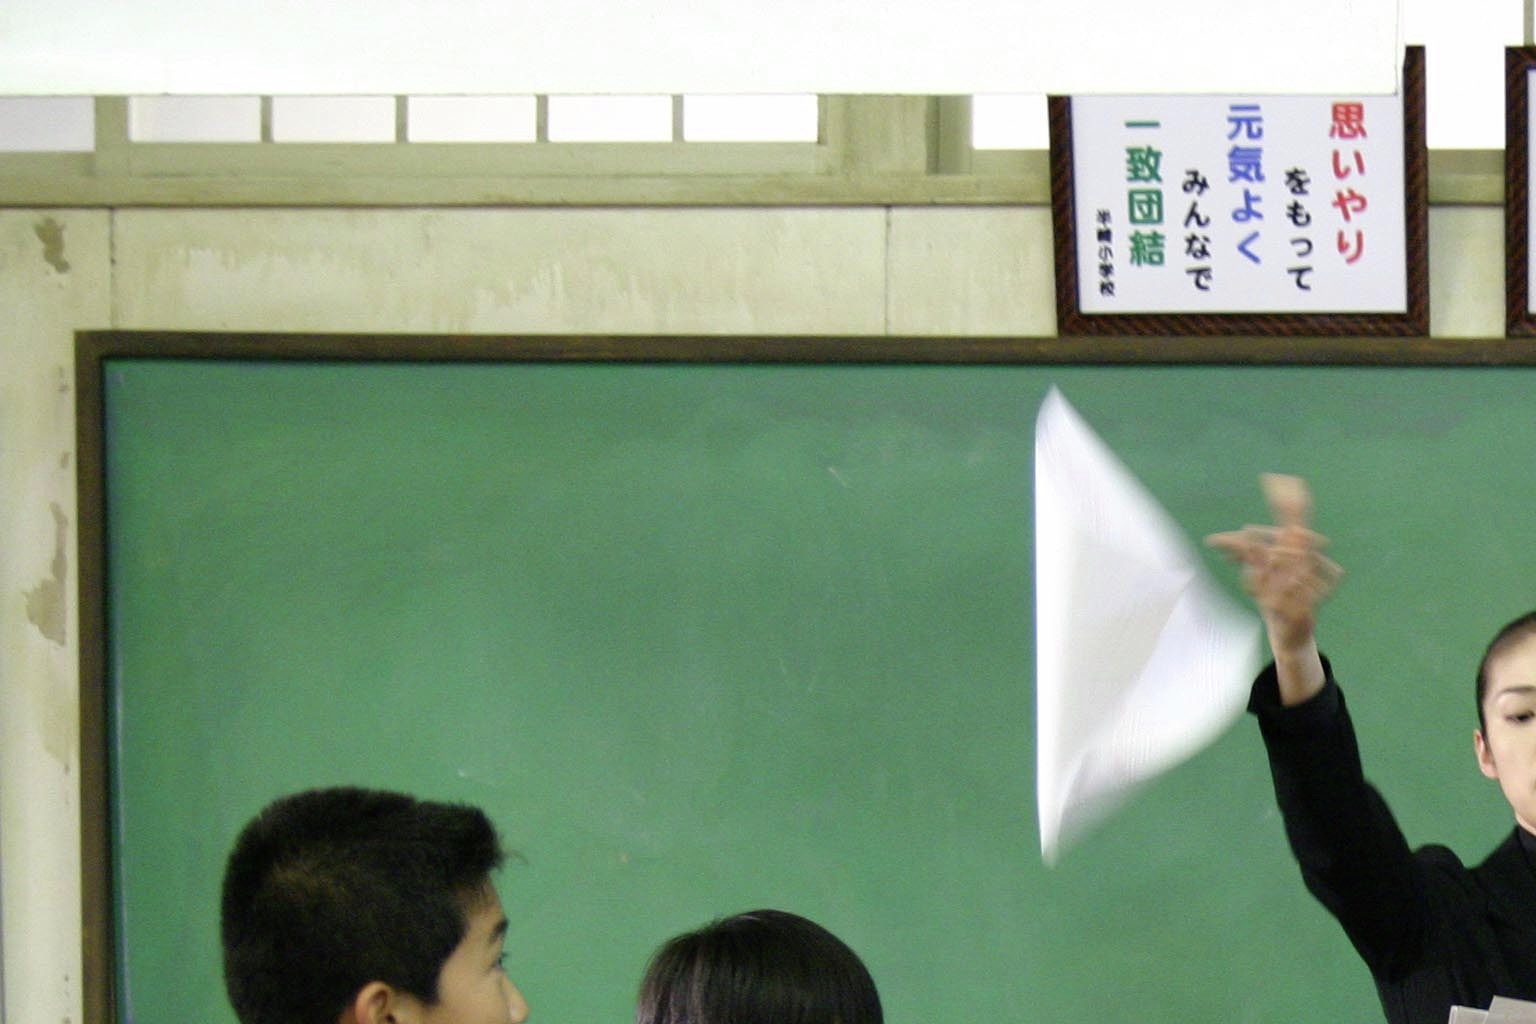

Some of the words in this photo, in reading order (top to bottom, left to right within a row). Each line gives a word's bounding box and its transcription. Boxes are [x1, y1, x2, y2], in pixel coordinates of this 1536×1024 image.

[1125, 121, 1165, 267] 一致団結
[1182, 169, 1212, 292] みんなで
[1227, 104, 1265, 264] 元気よく
[1285, 167, 1313, 291] をもって
[1329, 101, 1367, 264] 思いやり
